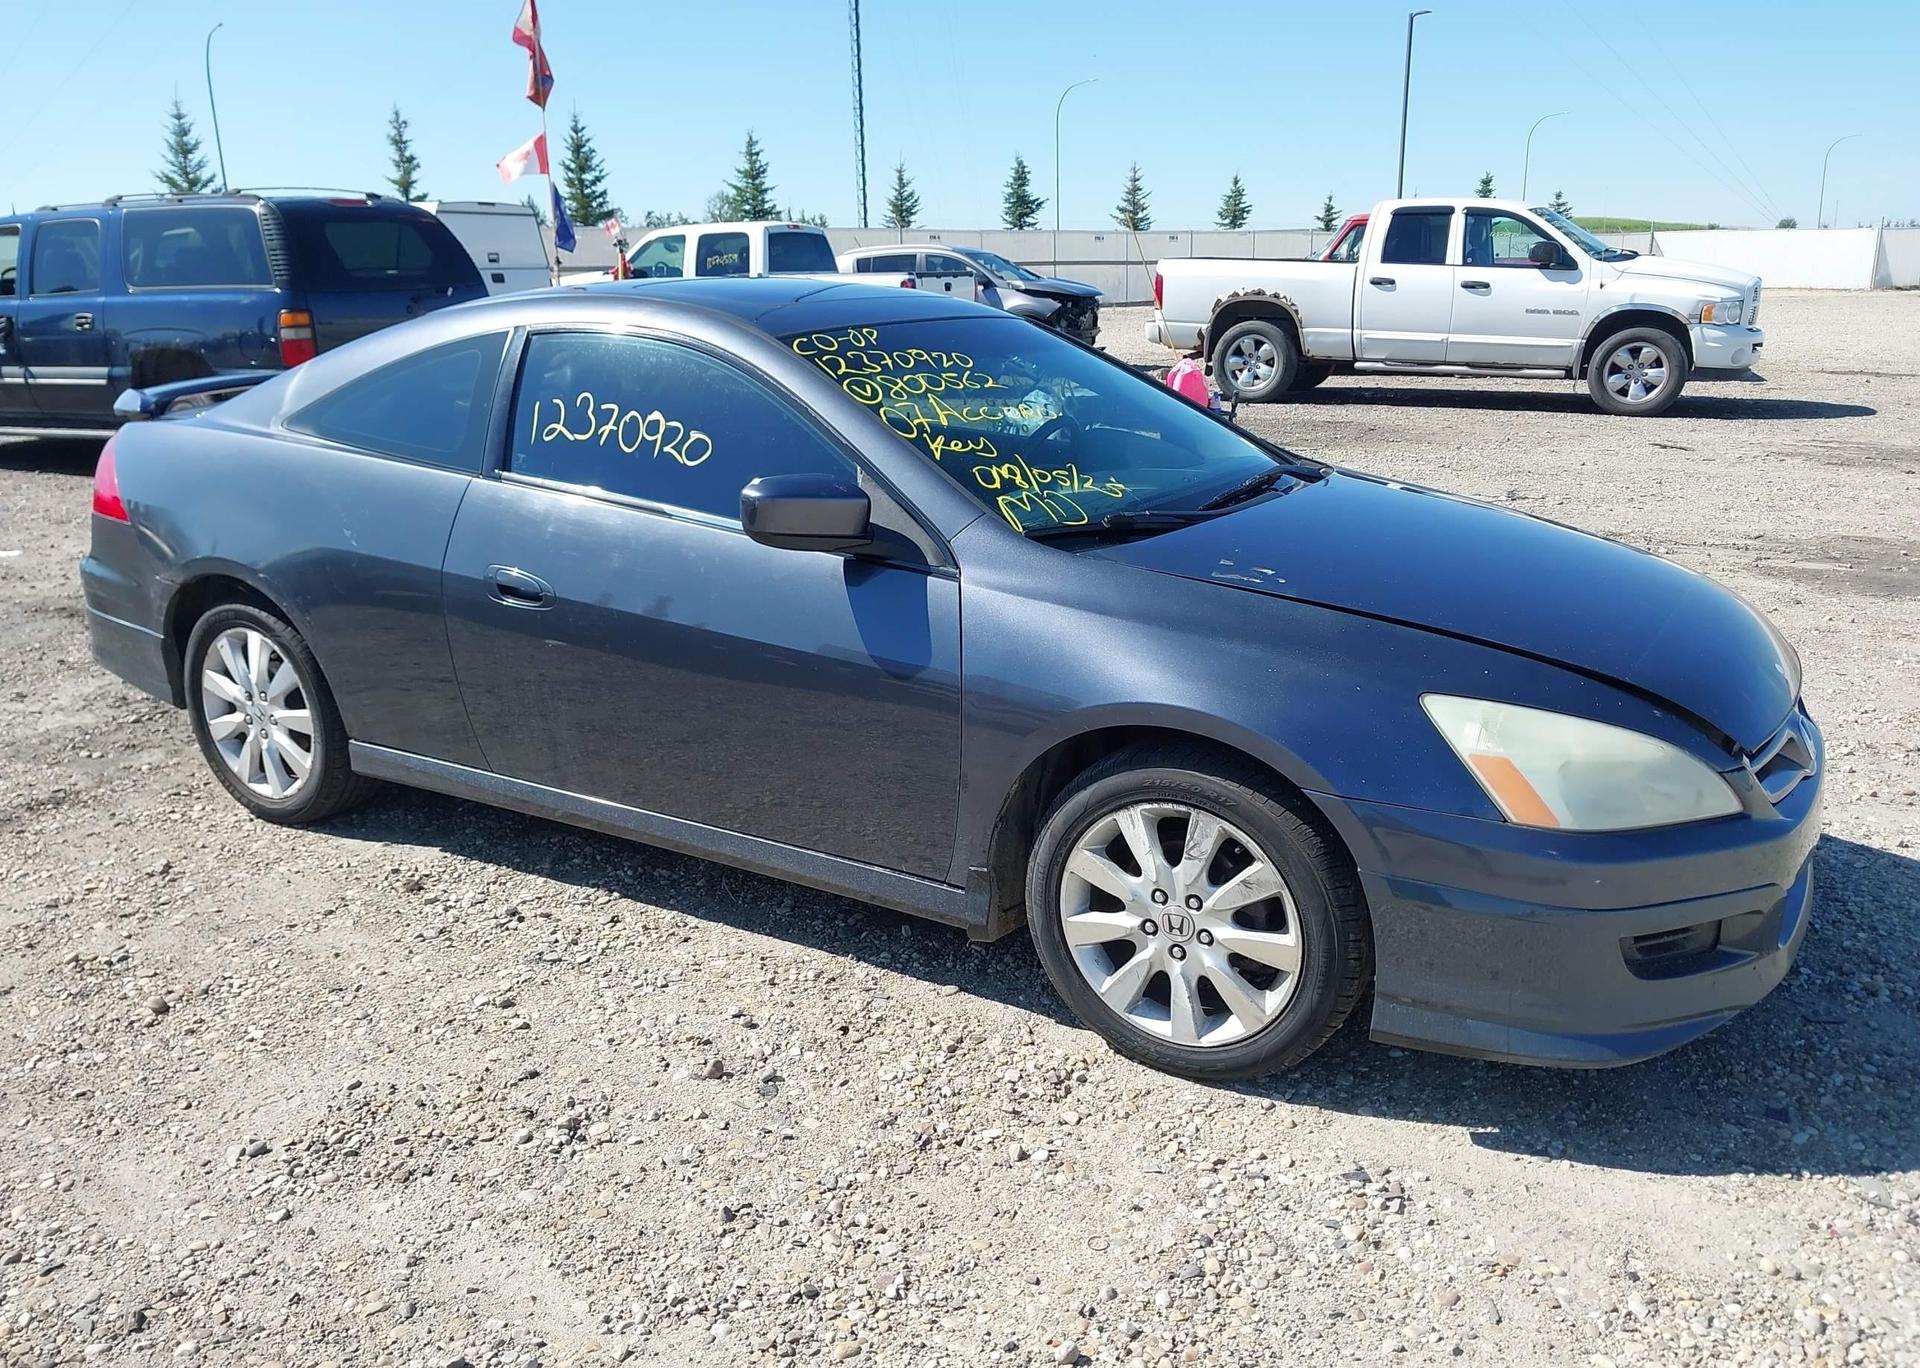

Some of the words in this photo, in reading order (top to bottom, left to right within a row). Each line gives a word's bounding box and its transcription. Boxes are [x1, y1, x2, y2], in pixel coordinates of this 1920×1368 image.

[815, 349, 974, 380] 12370920
[877, 370, 1009, 400] 800562
[530, 391, 713, 467] 12370920
